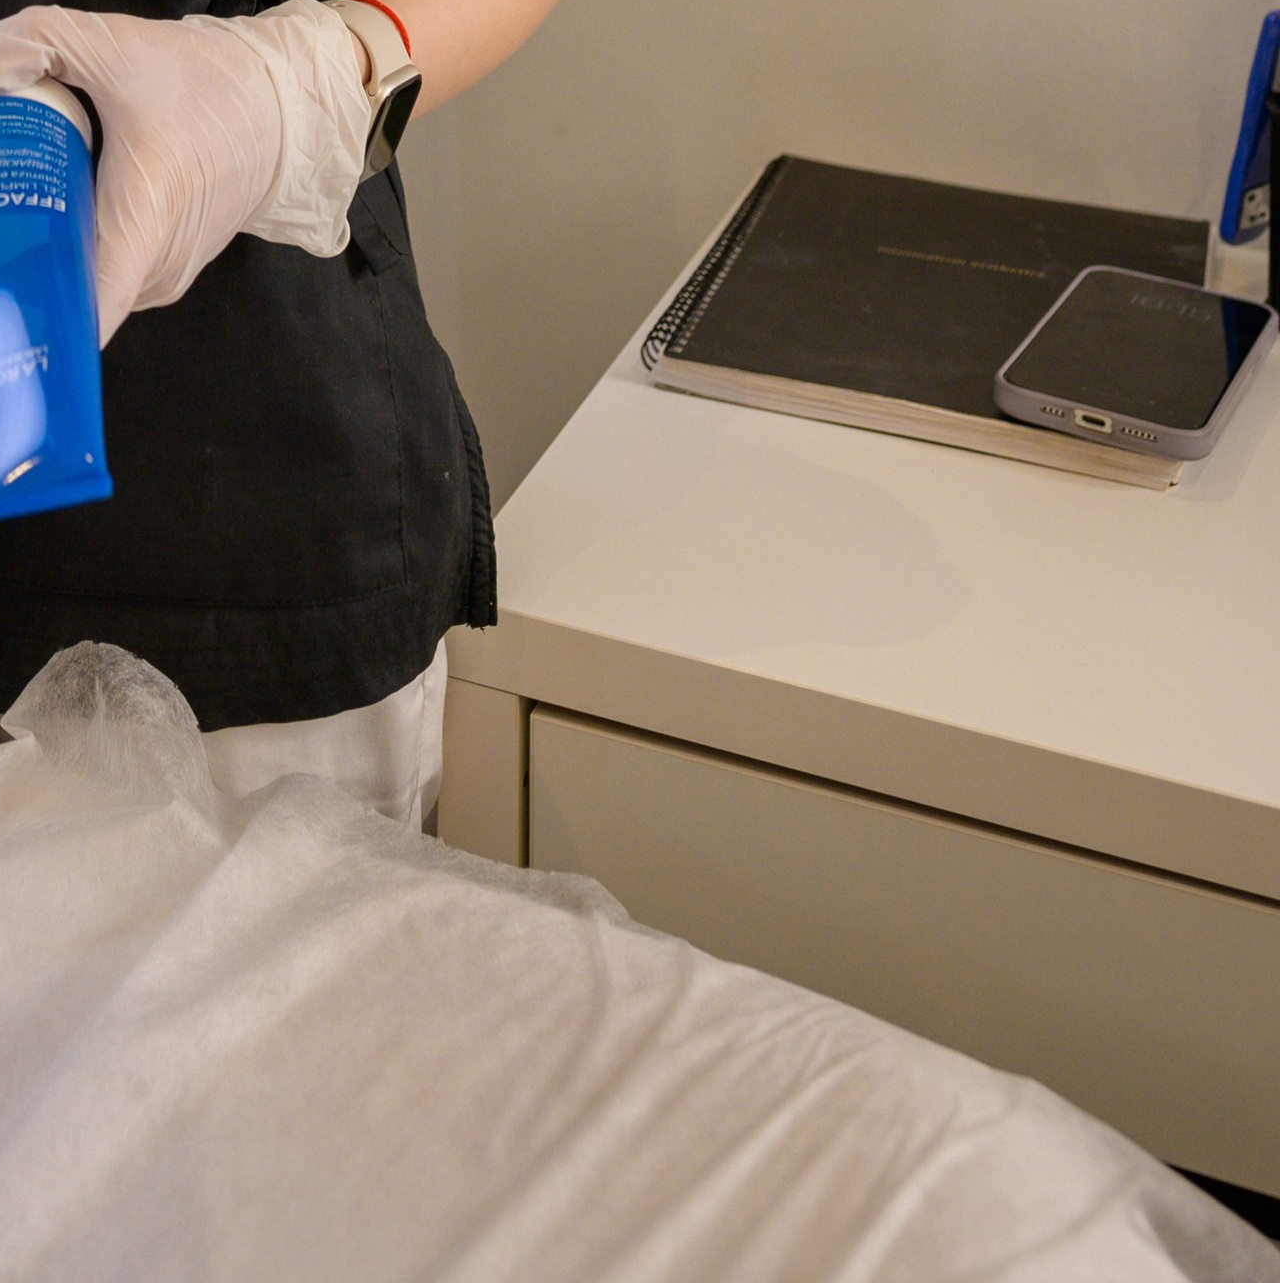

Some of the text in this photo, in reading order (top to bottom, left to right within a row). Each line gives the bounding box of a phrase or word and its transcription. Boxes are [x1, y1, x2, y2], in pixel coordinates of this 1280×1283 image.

[27, 104, 42, 114] ml
[45, 110, 66, 126] 200
[10, 170, 67, 189] Optimiza
[42, 183, 66, 199] GEL
[22, 356, 48, 377] LA
